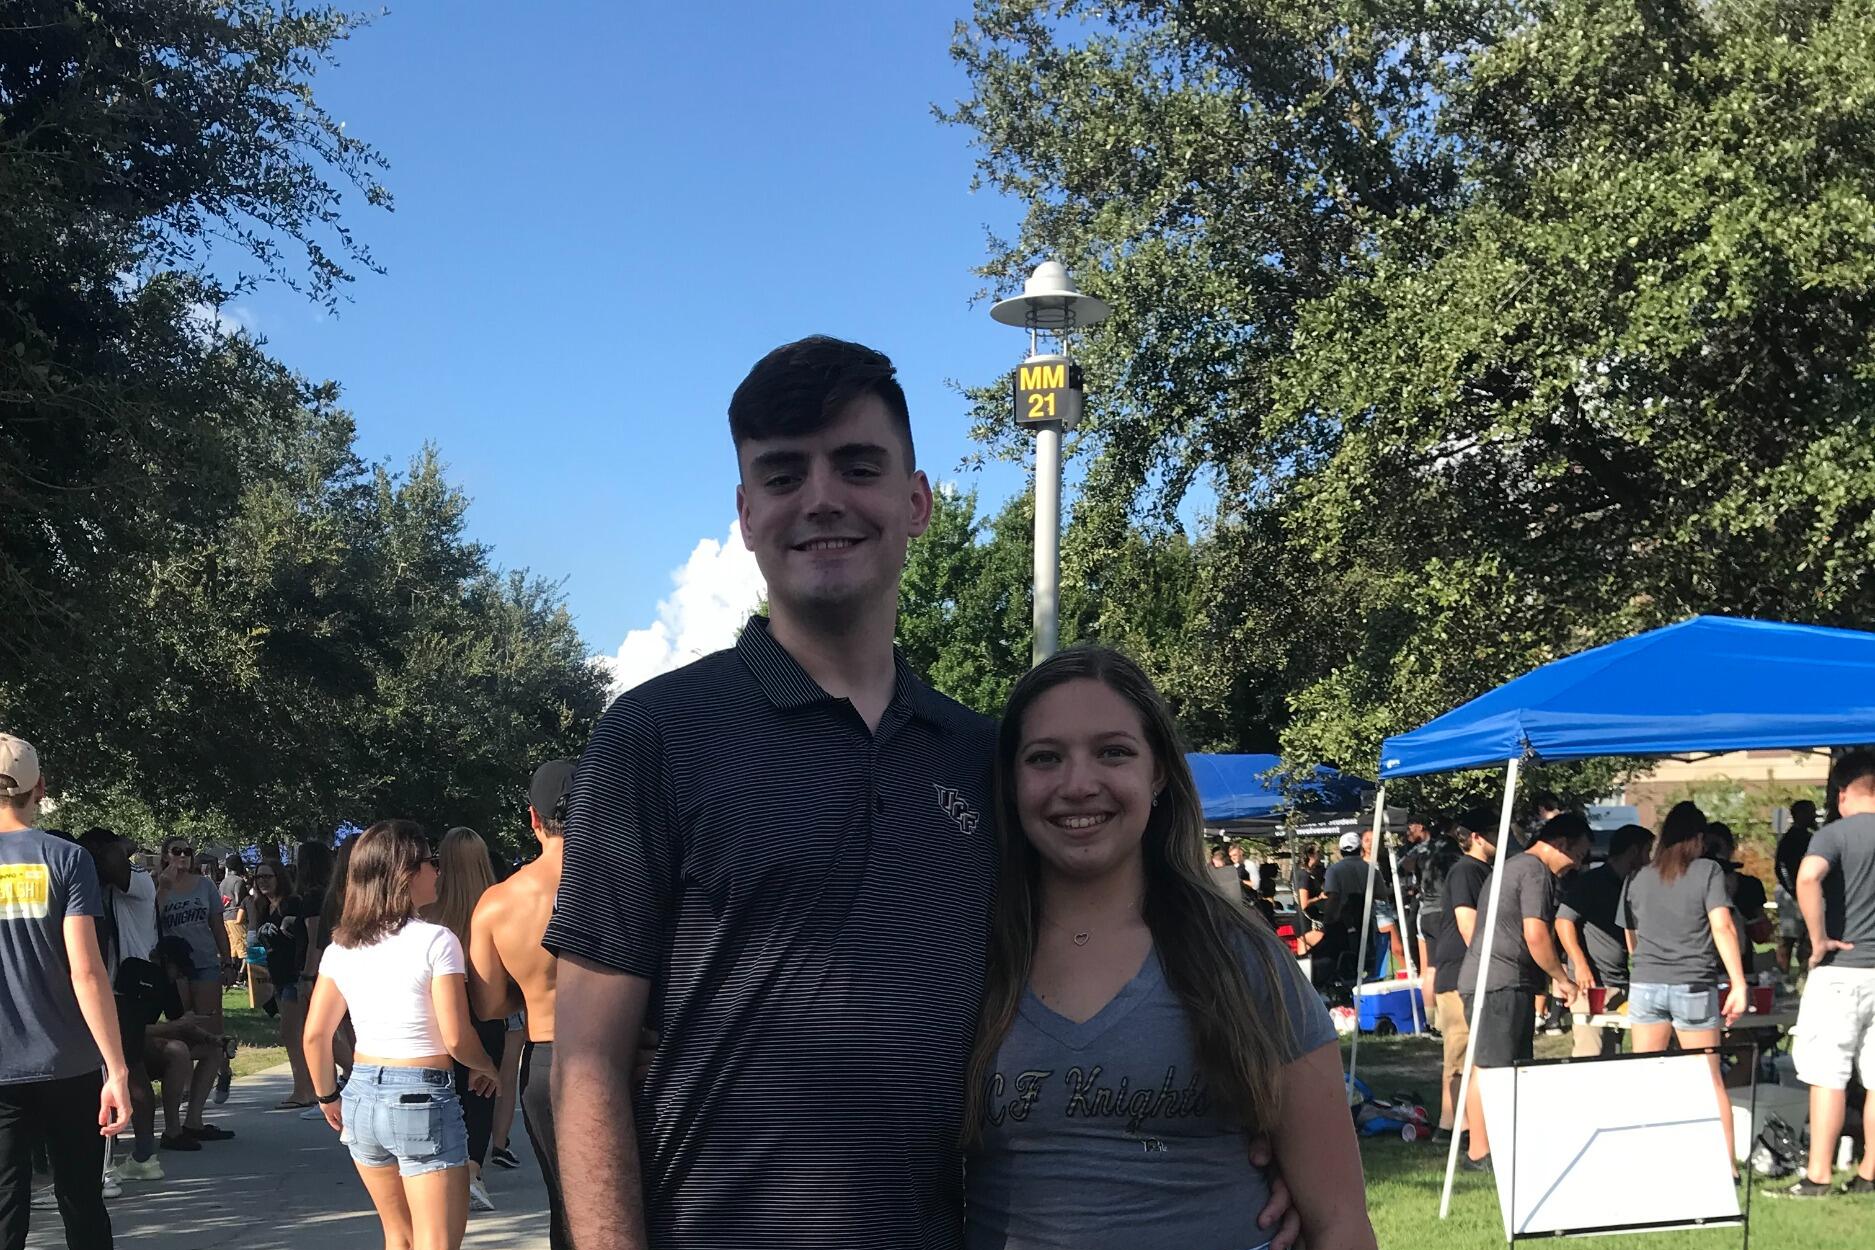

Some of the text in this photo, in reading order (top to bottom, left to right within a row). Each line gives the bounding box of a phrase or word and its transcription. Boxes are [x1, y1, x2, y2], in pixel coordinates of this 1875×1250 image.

[1020, 364, 1064, 391] MM
[1028, 392, 1055, 418] 21
[934, 784, 980, 834] UCF
[983, 1070, 1054, 1127] CF
